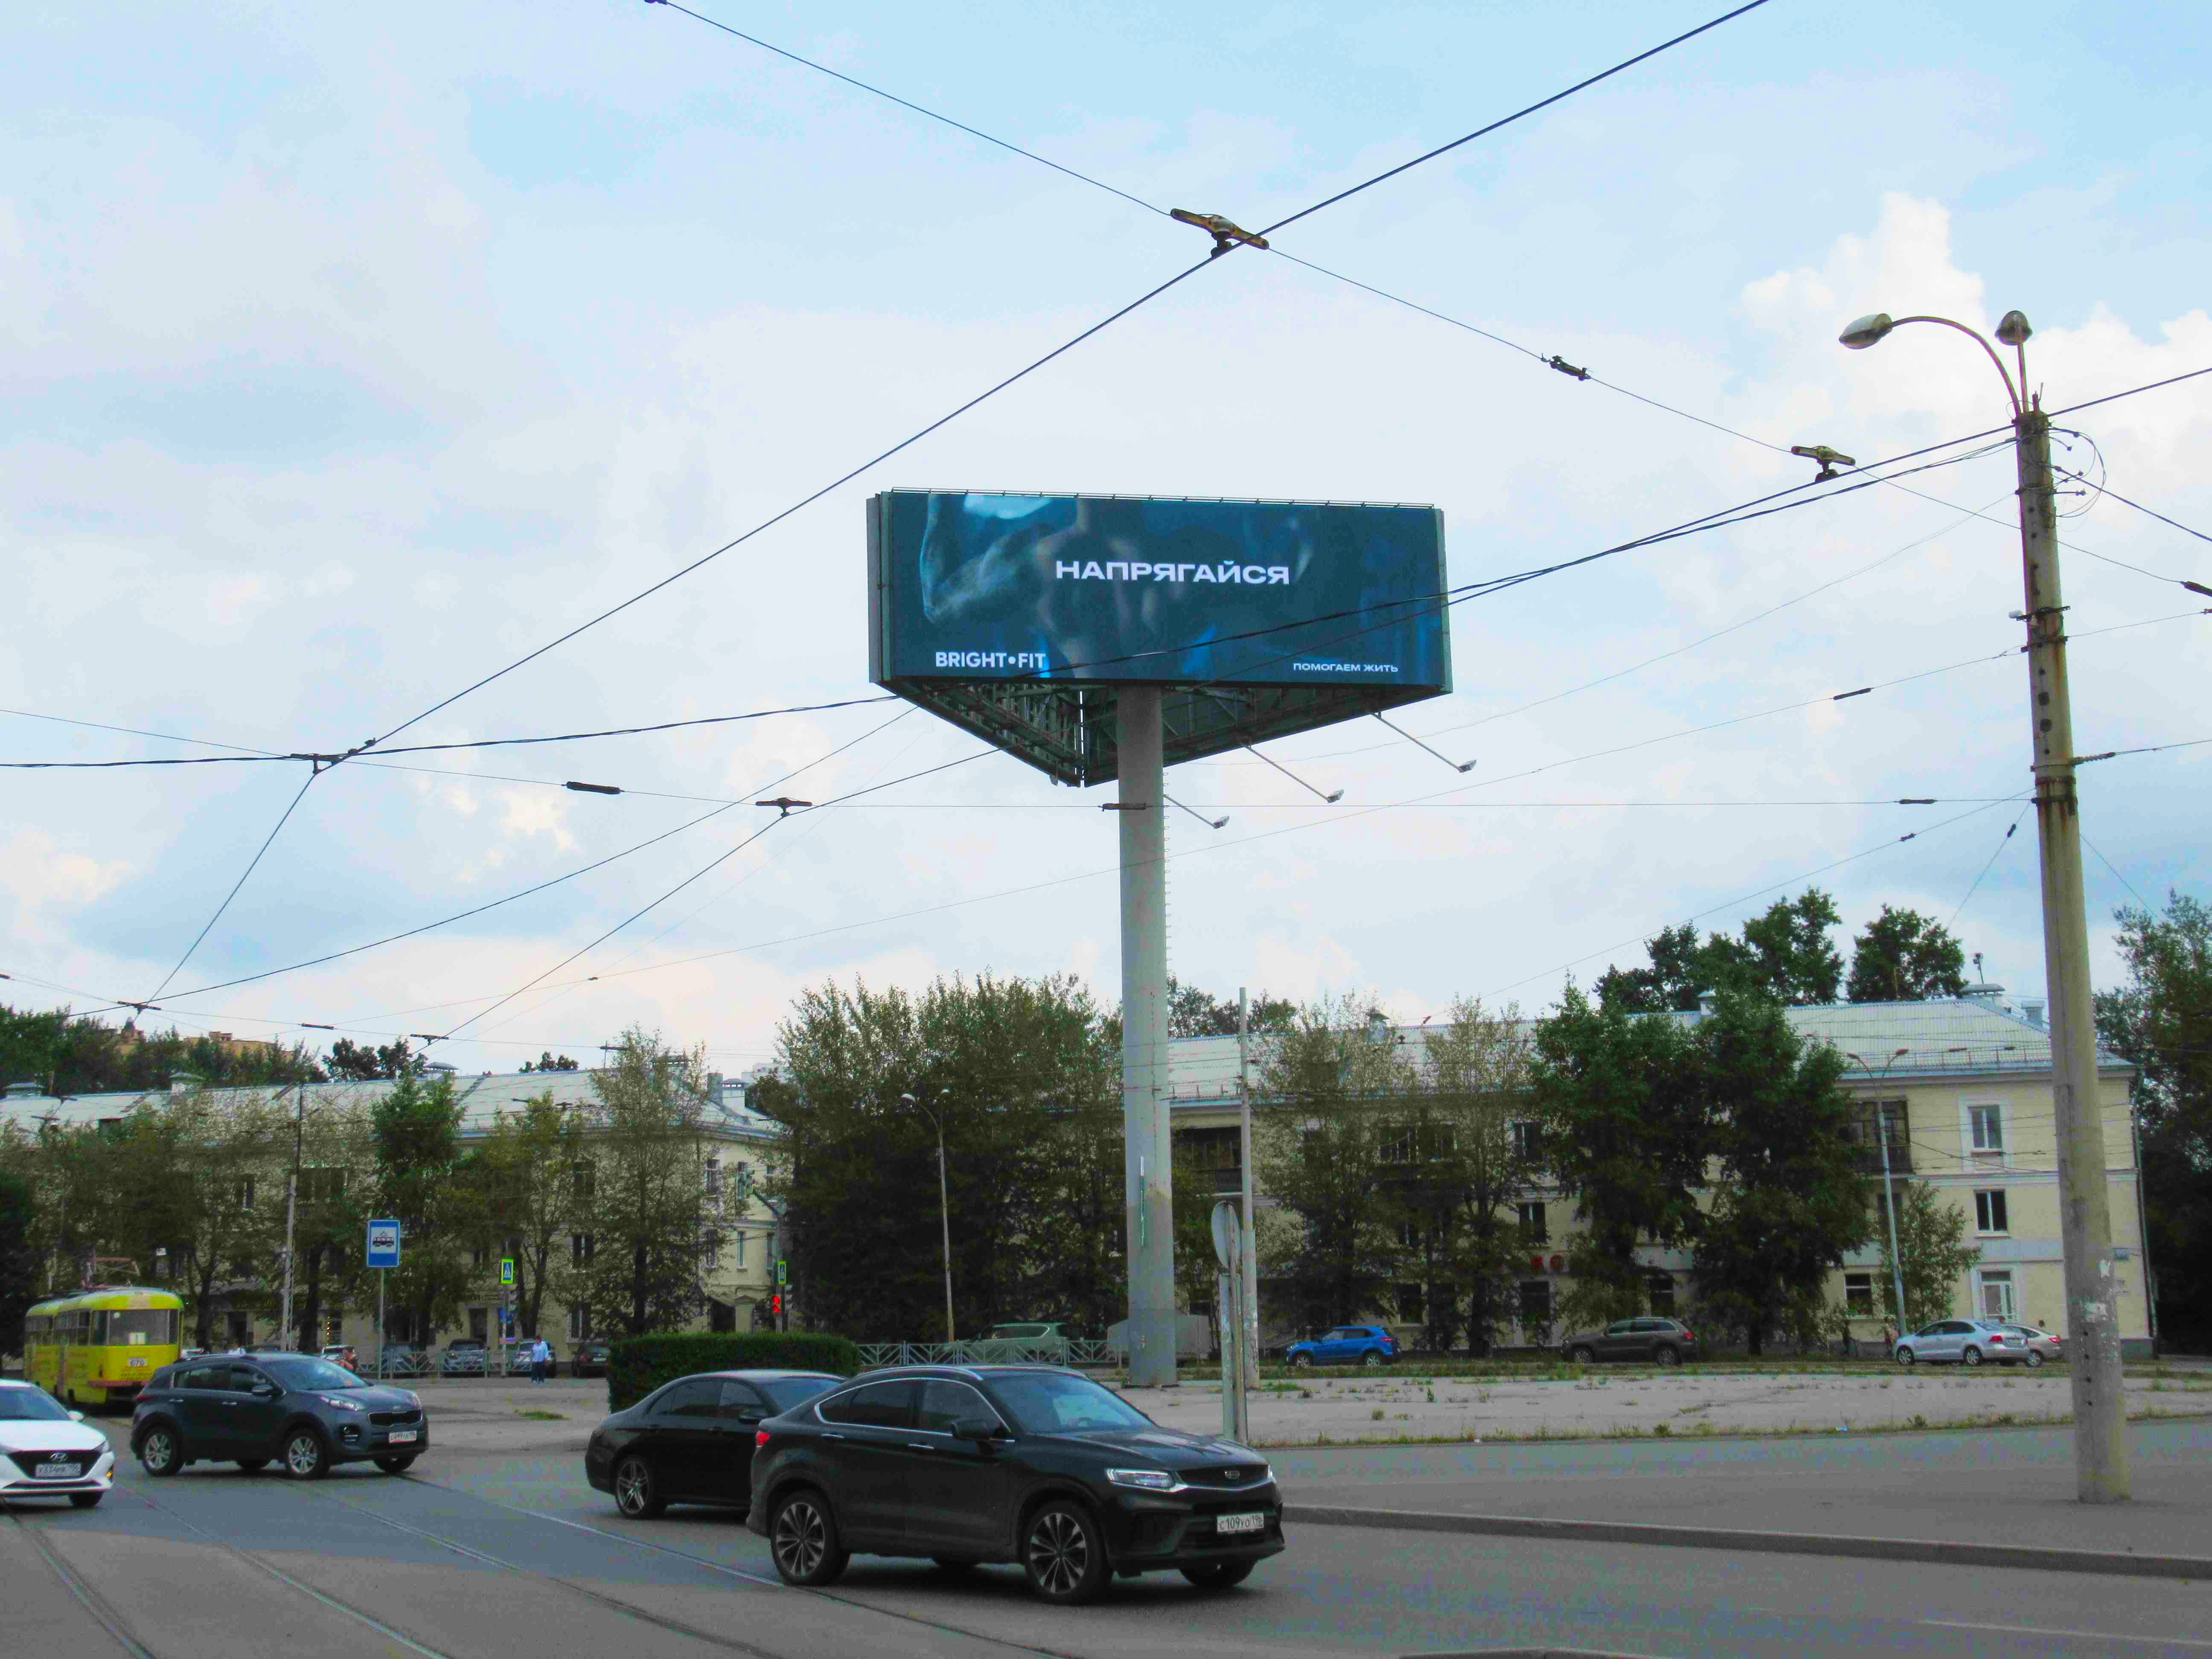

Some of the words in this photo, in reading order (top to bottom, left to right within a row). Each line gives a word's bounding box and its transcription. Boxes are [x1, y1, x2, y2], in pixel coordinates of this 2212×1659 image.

[1056, 560, 1289, 584] НАПРЯГАЙСЯ
[1293, 663, 1360, 672] ПОМОГАЕМ
[1364, 664, 1398, 672] ЖИТЬ
